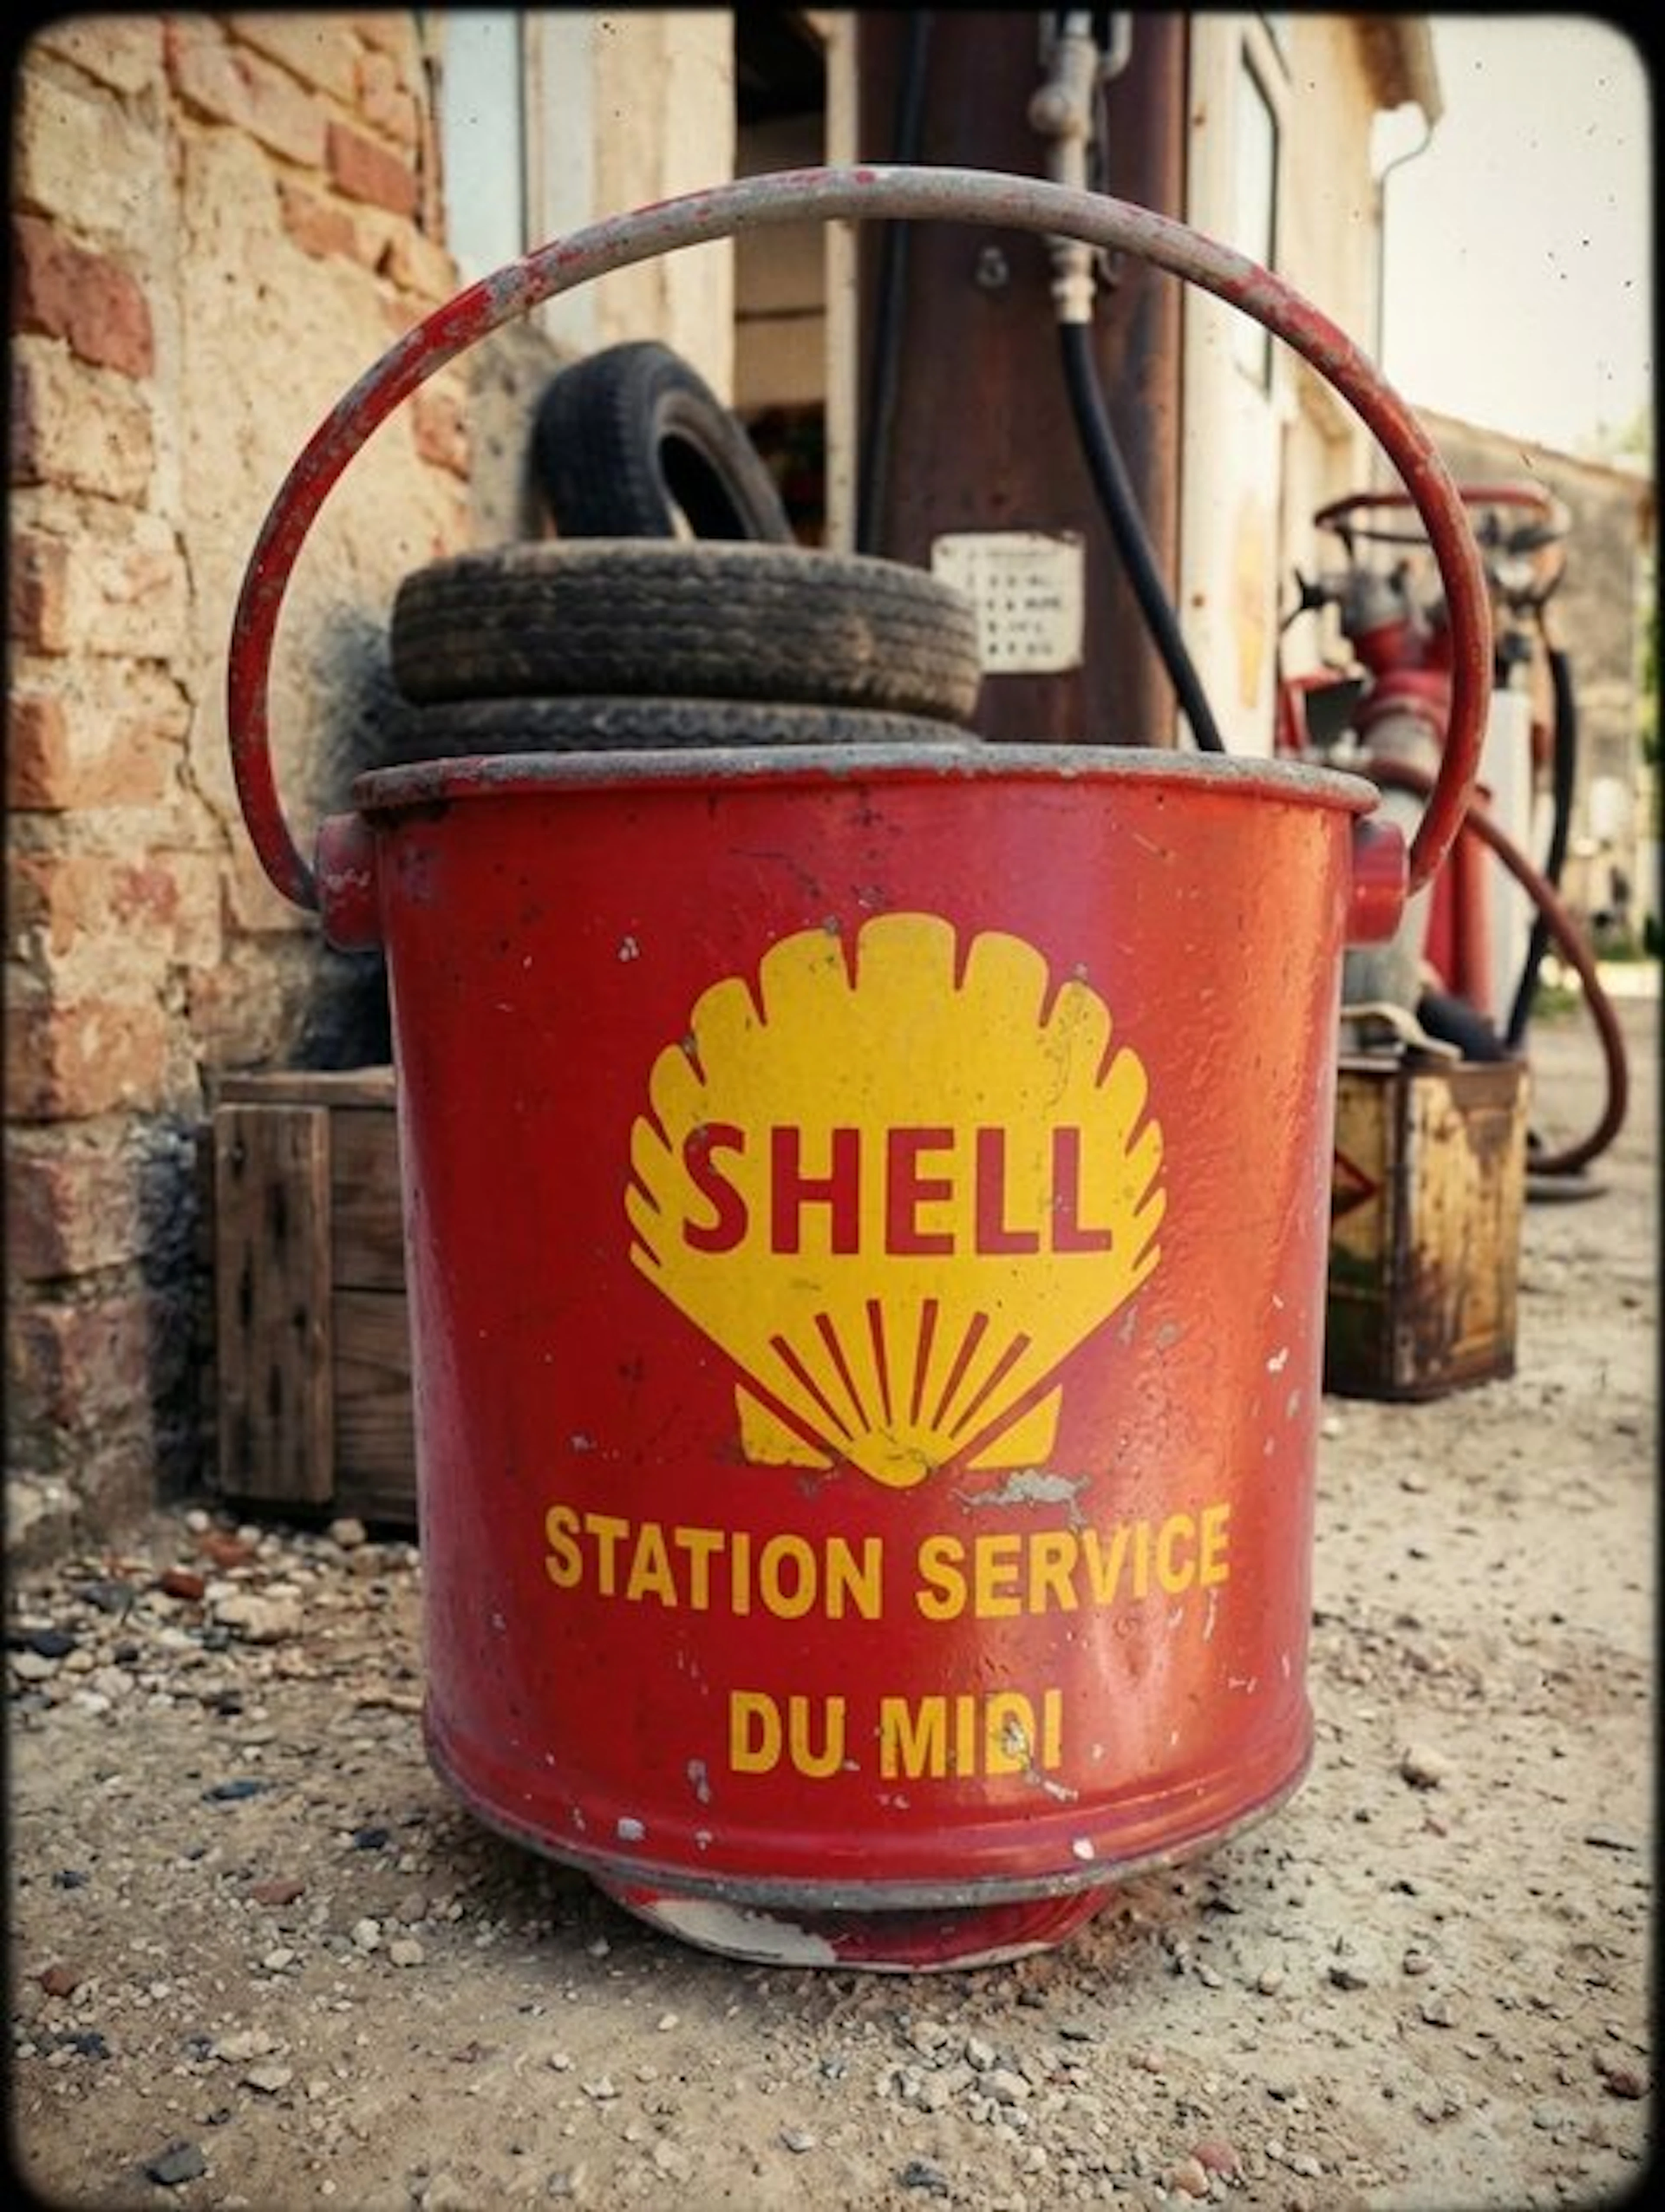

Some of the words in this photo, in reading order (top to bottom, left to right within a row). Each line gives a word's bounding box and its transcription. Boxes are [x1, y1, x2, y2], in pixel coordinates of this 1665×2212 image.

[683, 1122, 1112, 1254] SHELL
[545, 1506, 883, 1620] STATION
[916, 1503, 1231, 1620] SERVICE
[730, 1689, 846, 1778] DU
[880, 1689, 1063, 1780] MIDI
